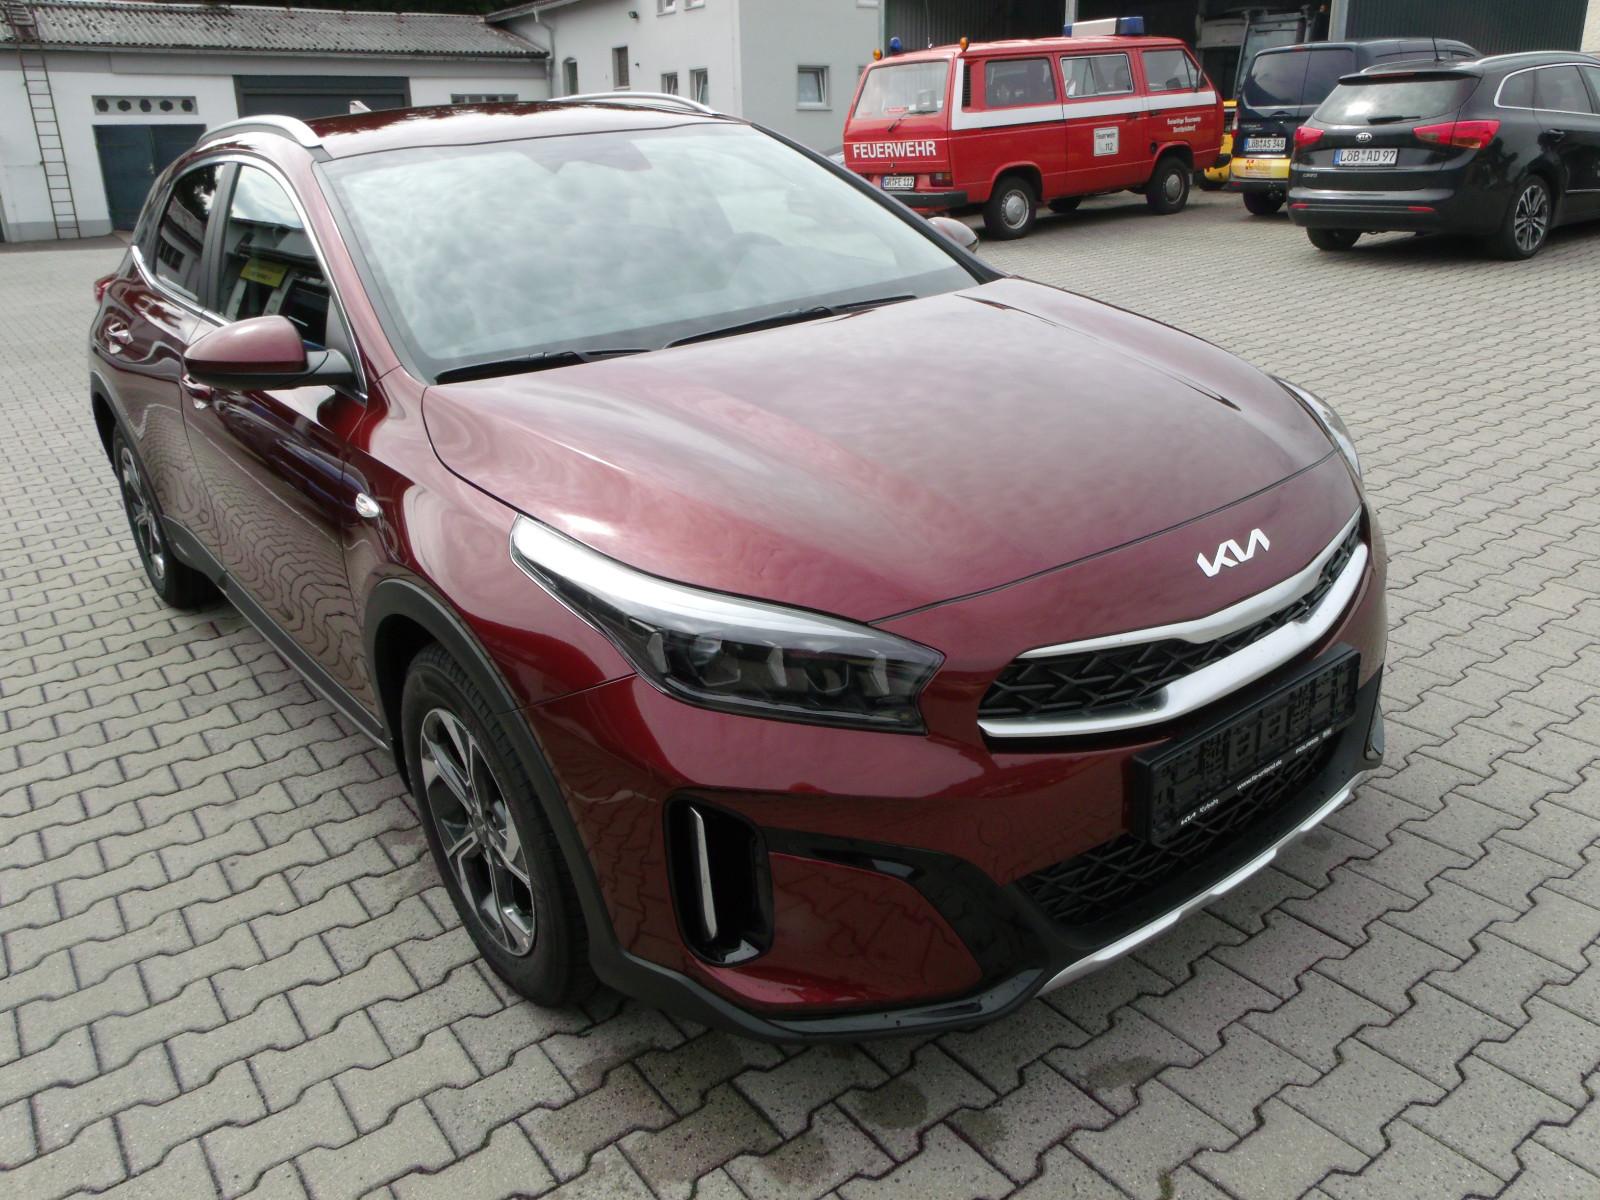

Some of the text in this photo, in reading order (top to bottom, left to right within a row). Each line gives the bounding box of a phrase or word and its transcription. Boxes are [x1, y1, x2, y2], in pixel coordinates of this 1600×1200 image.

[853, 141, 936, 158] FEUERWEHR
[1105, 143, 1113, 151] 112
[1340, 150, 1396, 162] LÖB AD 97
[904, 177, 914, 187] 112
[1197, 528, 1270, 577] KIA
